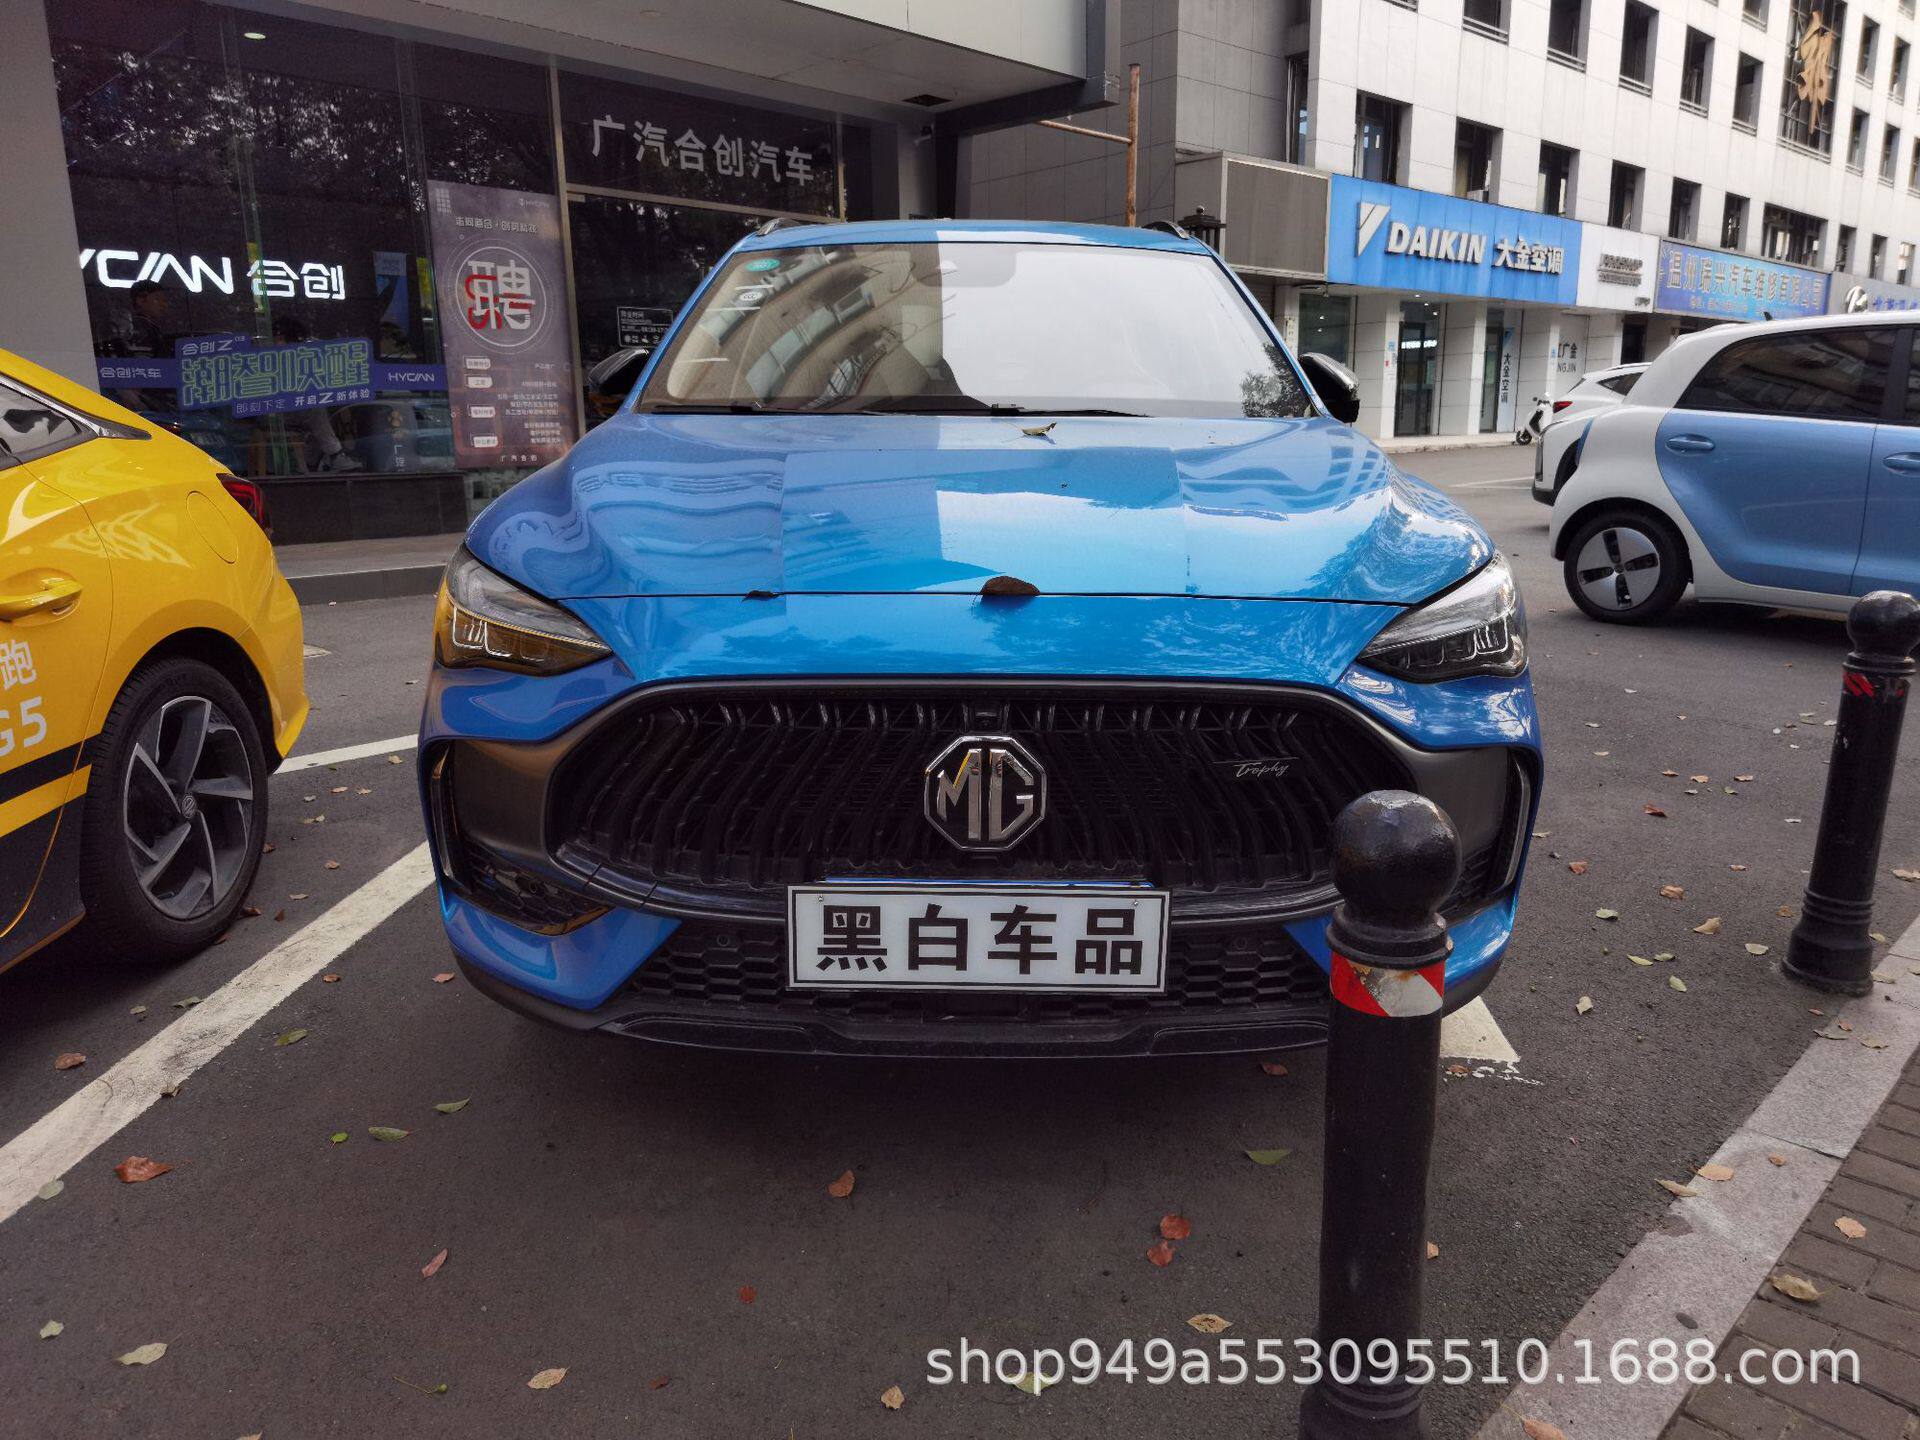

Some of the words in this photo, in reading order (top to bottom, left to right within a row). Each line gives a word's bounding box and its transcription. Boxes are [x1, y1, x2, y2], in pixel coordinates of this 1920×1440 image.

[591, 114, 814, 187] 广汽合创汽车
[1386, 221, 1487, 264] DAIKIN
[1492, 236, 1565, 275] 大金空调
[246, 259, 346, 300] 合创
[464, 259, 536, 330] 聘
[100, 367, 162, 378] 合创汽车
[181, 341, 370, 406] 潮智唤醒
[388, 372, 435, 382] HYCAN
[1500, 352, 1512, 404] 大金空调
[236, 399, 286, 414] 即刻下定
[0, 638, 37, 691] 跑
[1232, 761, 1290, 778] Trophy
[936, 747, 1035, 842] MG
[815, 903, 1143, 976] 黑白车品
